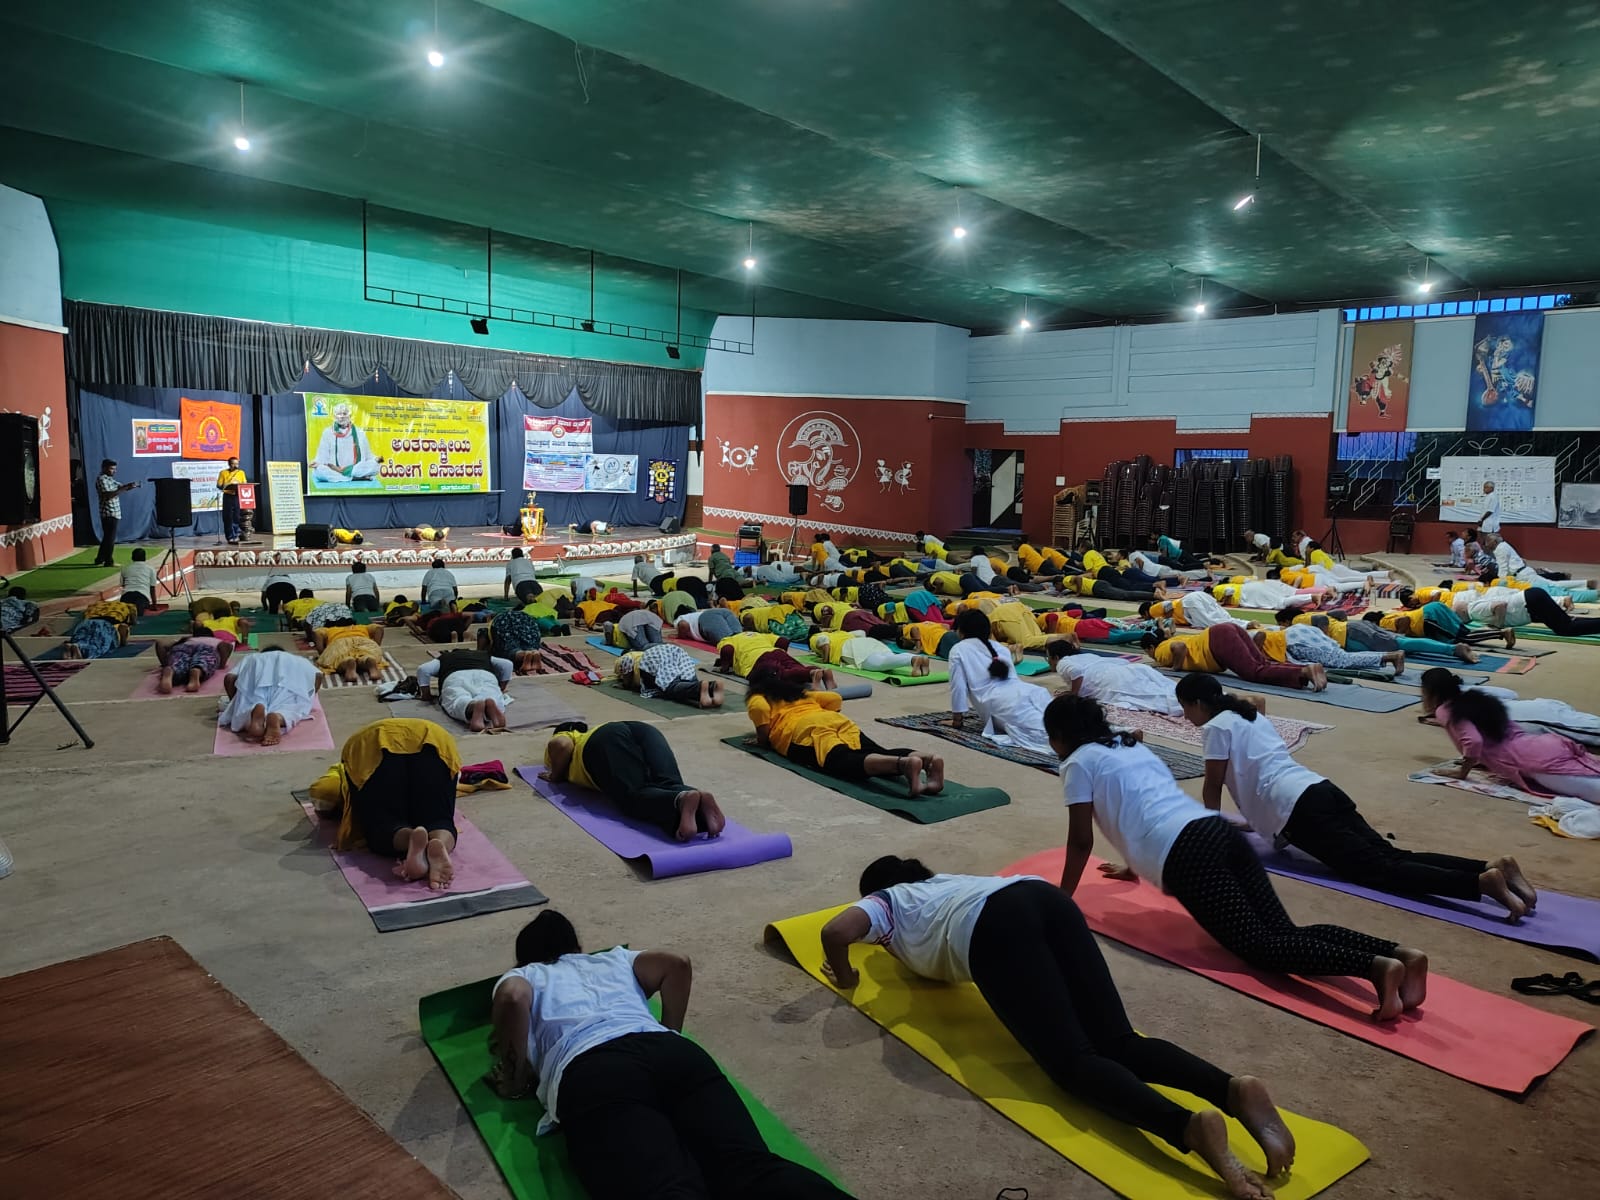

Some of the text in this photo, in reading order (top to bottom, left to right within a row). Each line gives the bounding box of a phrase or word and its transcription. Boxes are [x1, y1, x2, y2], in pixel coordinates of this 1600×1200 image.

[391, 439, 471, 464] ಅಂತರಾಷ್ಟ್ರೀಯ
[379, 459, 483, 478] ಯೋಗ ದಿನಾಚರಣೆ
